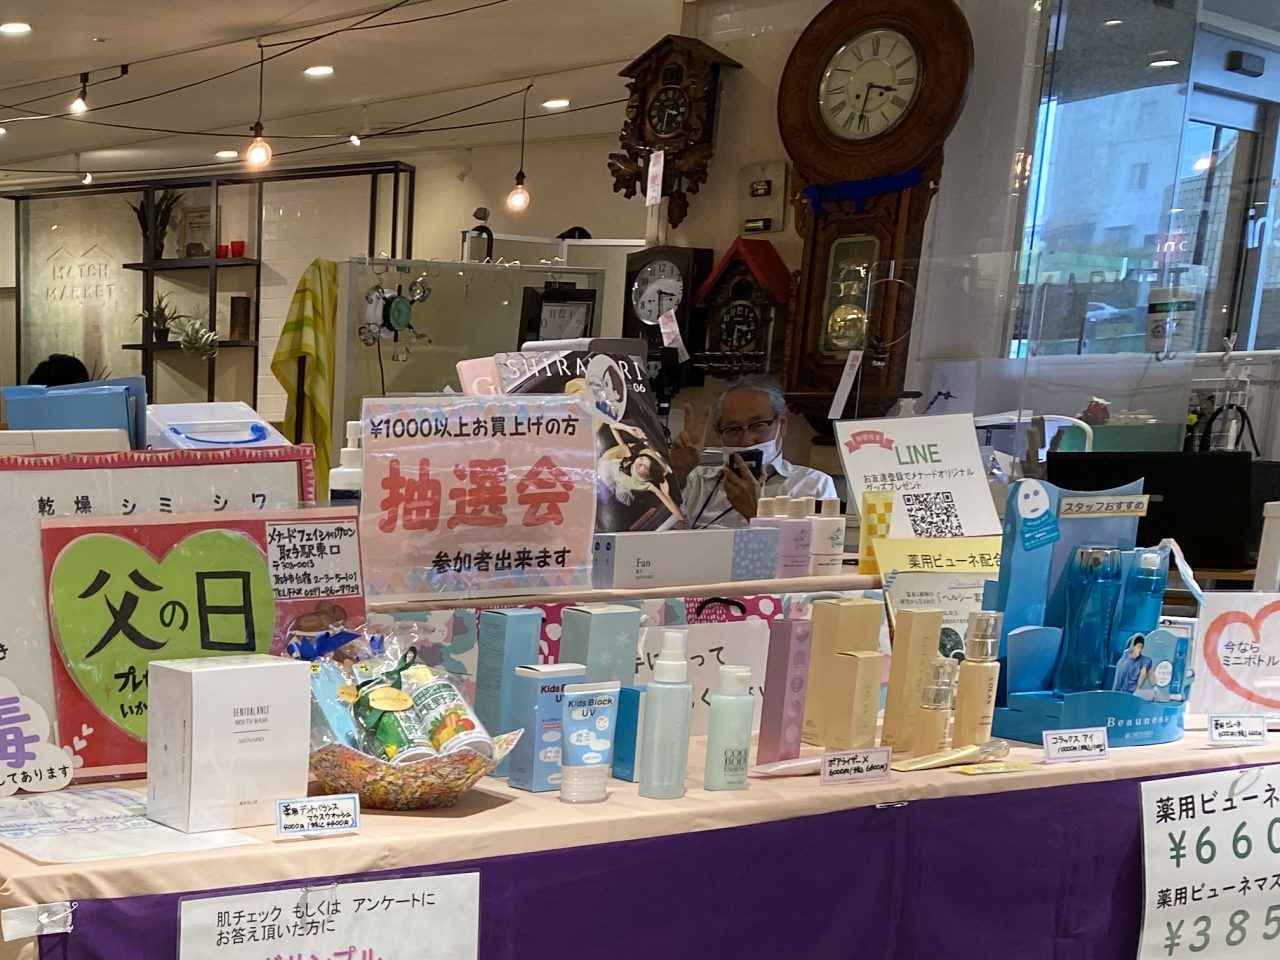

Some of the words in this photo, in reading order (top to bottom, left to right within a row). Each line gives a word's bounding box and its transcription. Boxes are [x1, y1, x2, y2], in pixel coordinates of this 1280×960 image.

[506, 357, 644, 381] SHIRARI
[632, 383, 647, 393] 06
[369, 414, 580, 440] ¥1000以上お買上げの方
[894, 443, 942, 466] LINE
[864, 468, 975, 484] お友達登録でメナードオリジナル
[378, 456, 576, 533] 抽選会
[1064, 501, 1145, 513] スタッフおすすめ
[277, 542, 341, 560] 取手駅東口
[431, 547, 572, 574] 参加者出来ます
[635, 557, 651, 568] Fan
[78, 568, 257, 660] 父の日
[1223, 641, 1260, 654] 今なら
[1222, 655, 1280, 667] ミニボトル
[114, 666, 148, 695] プレ
[582, 708, 596, 717] UV
[215, 905, 283, 928] 肌チェック
[292, 896, 342, 918] もしくは
[352, 891, 437, 915] アンケートに
[215, 918, 336, 947] お答え頂いた方に
